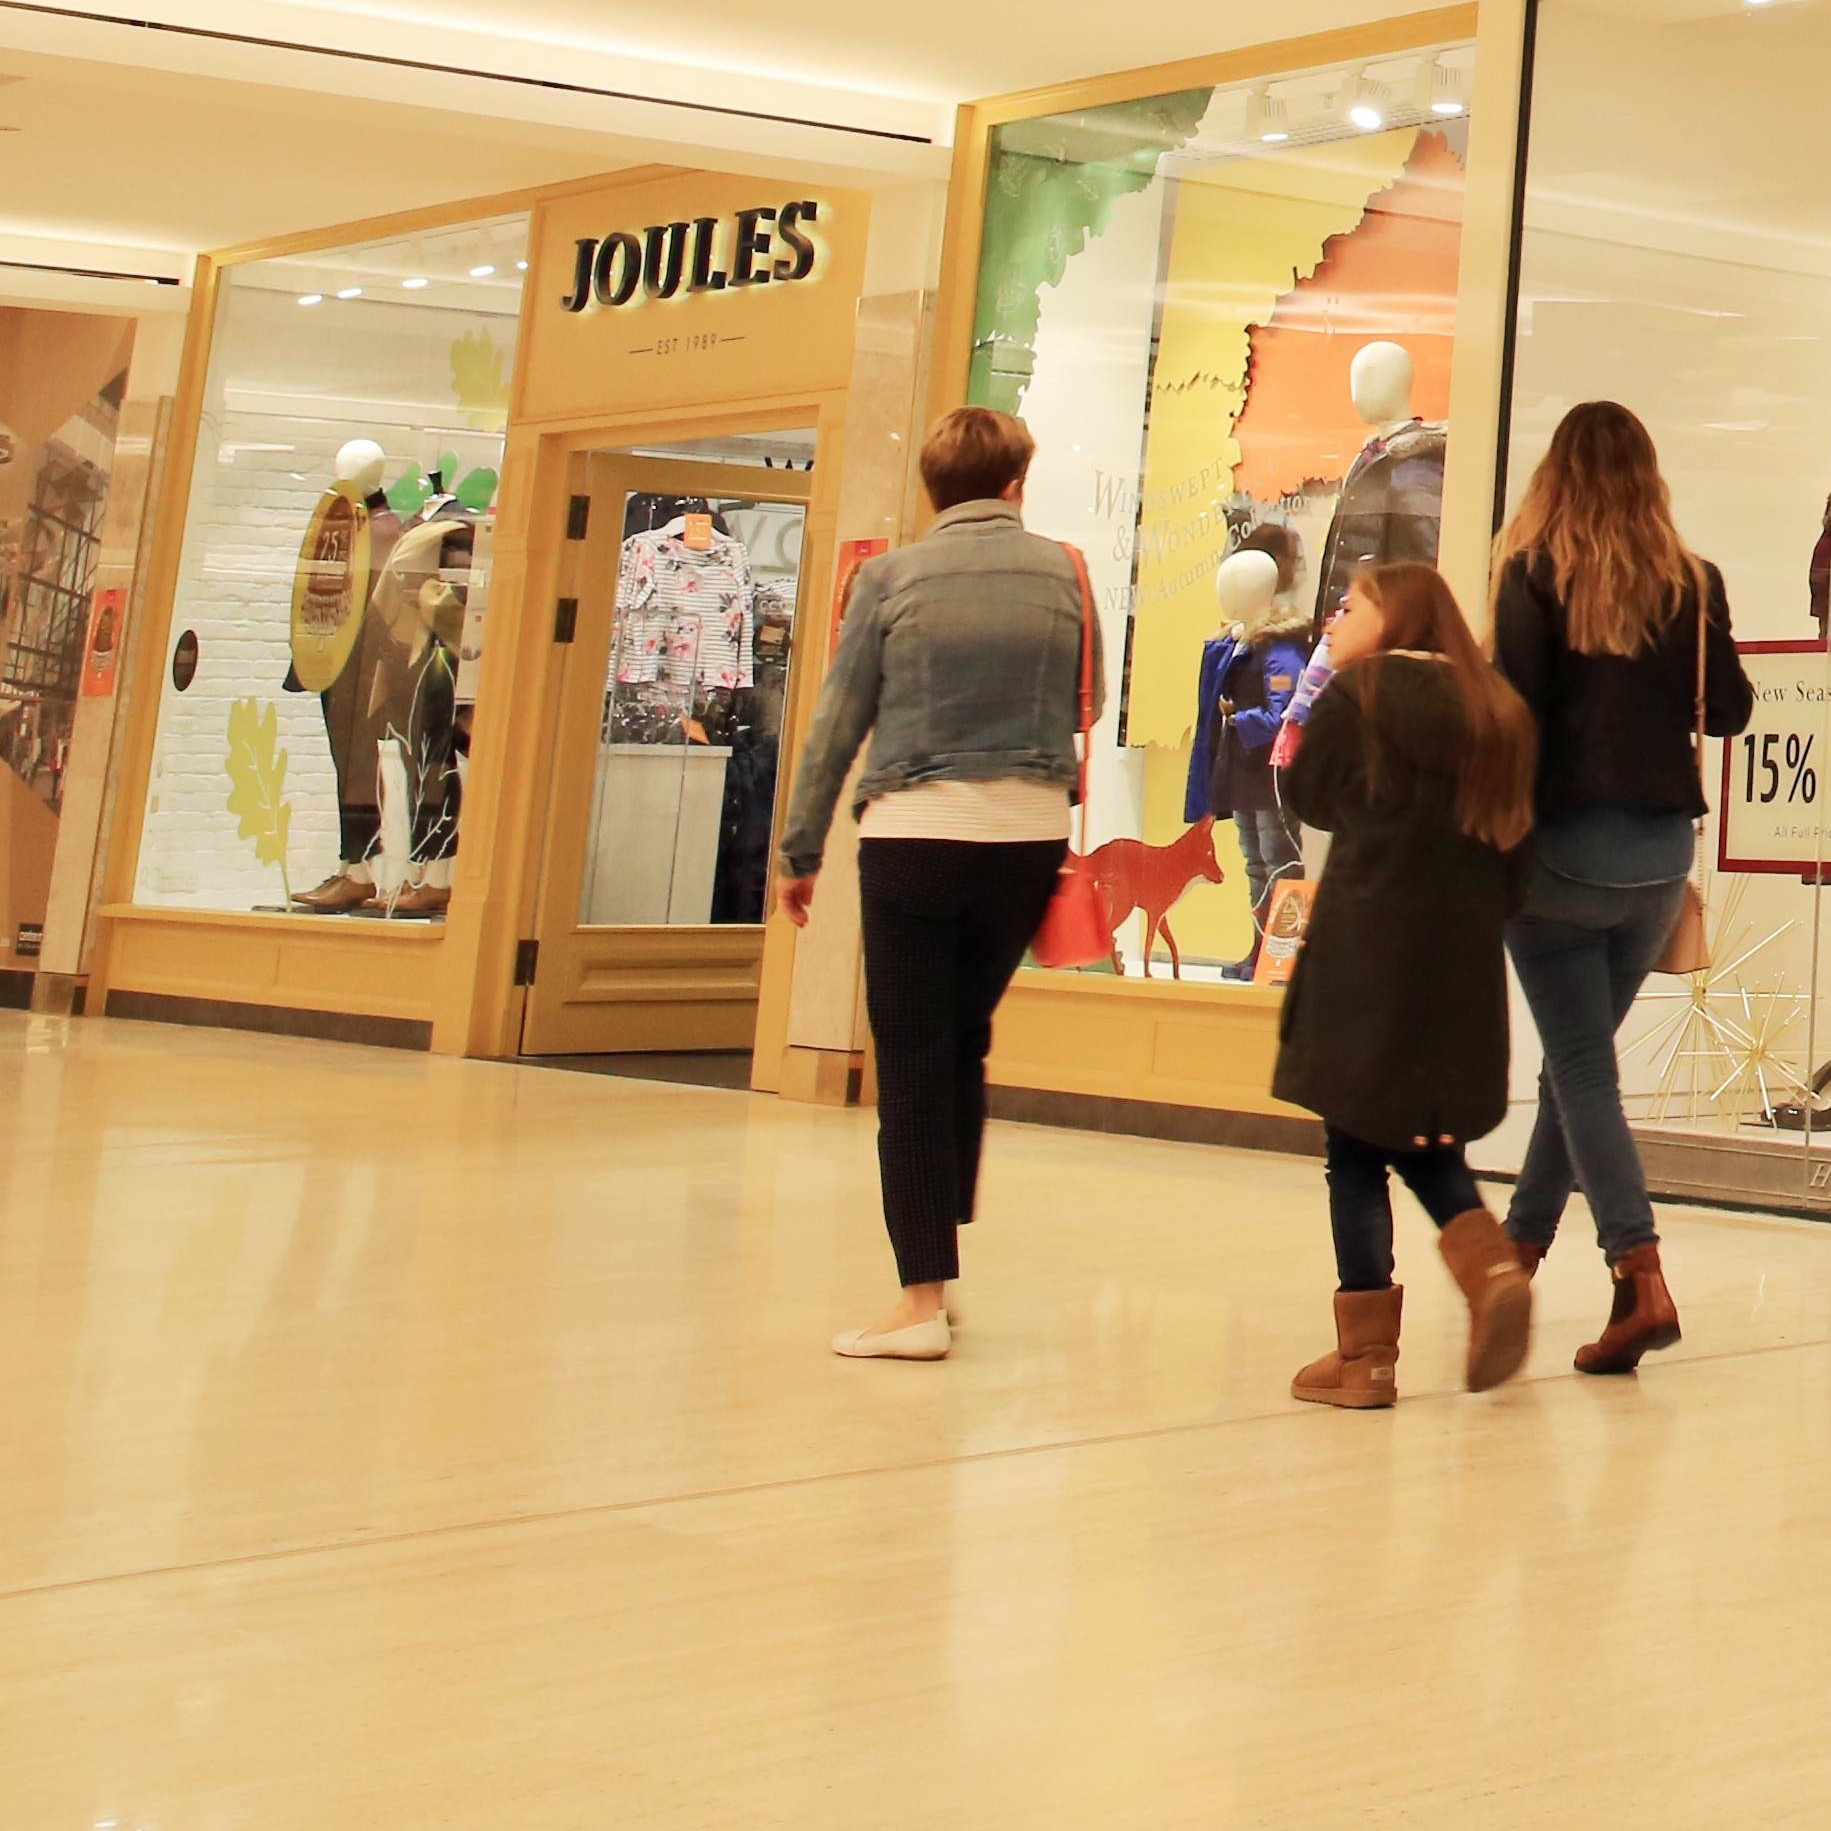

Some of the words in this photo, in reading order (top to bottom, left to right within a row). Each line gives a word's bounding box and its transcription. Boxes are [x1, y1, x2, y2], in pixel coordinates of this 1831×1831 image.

[559, 200, 818, 313] JOULES
[656, 338, 679, 356] EST
[1744, 732, 1816, 804] 15%
[1774, 826, 1788, 838] All
[1791, 826, 1810, 838] Full
